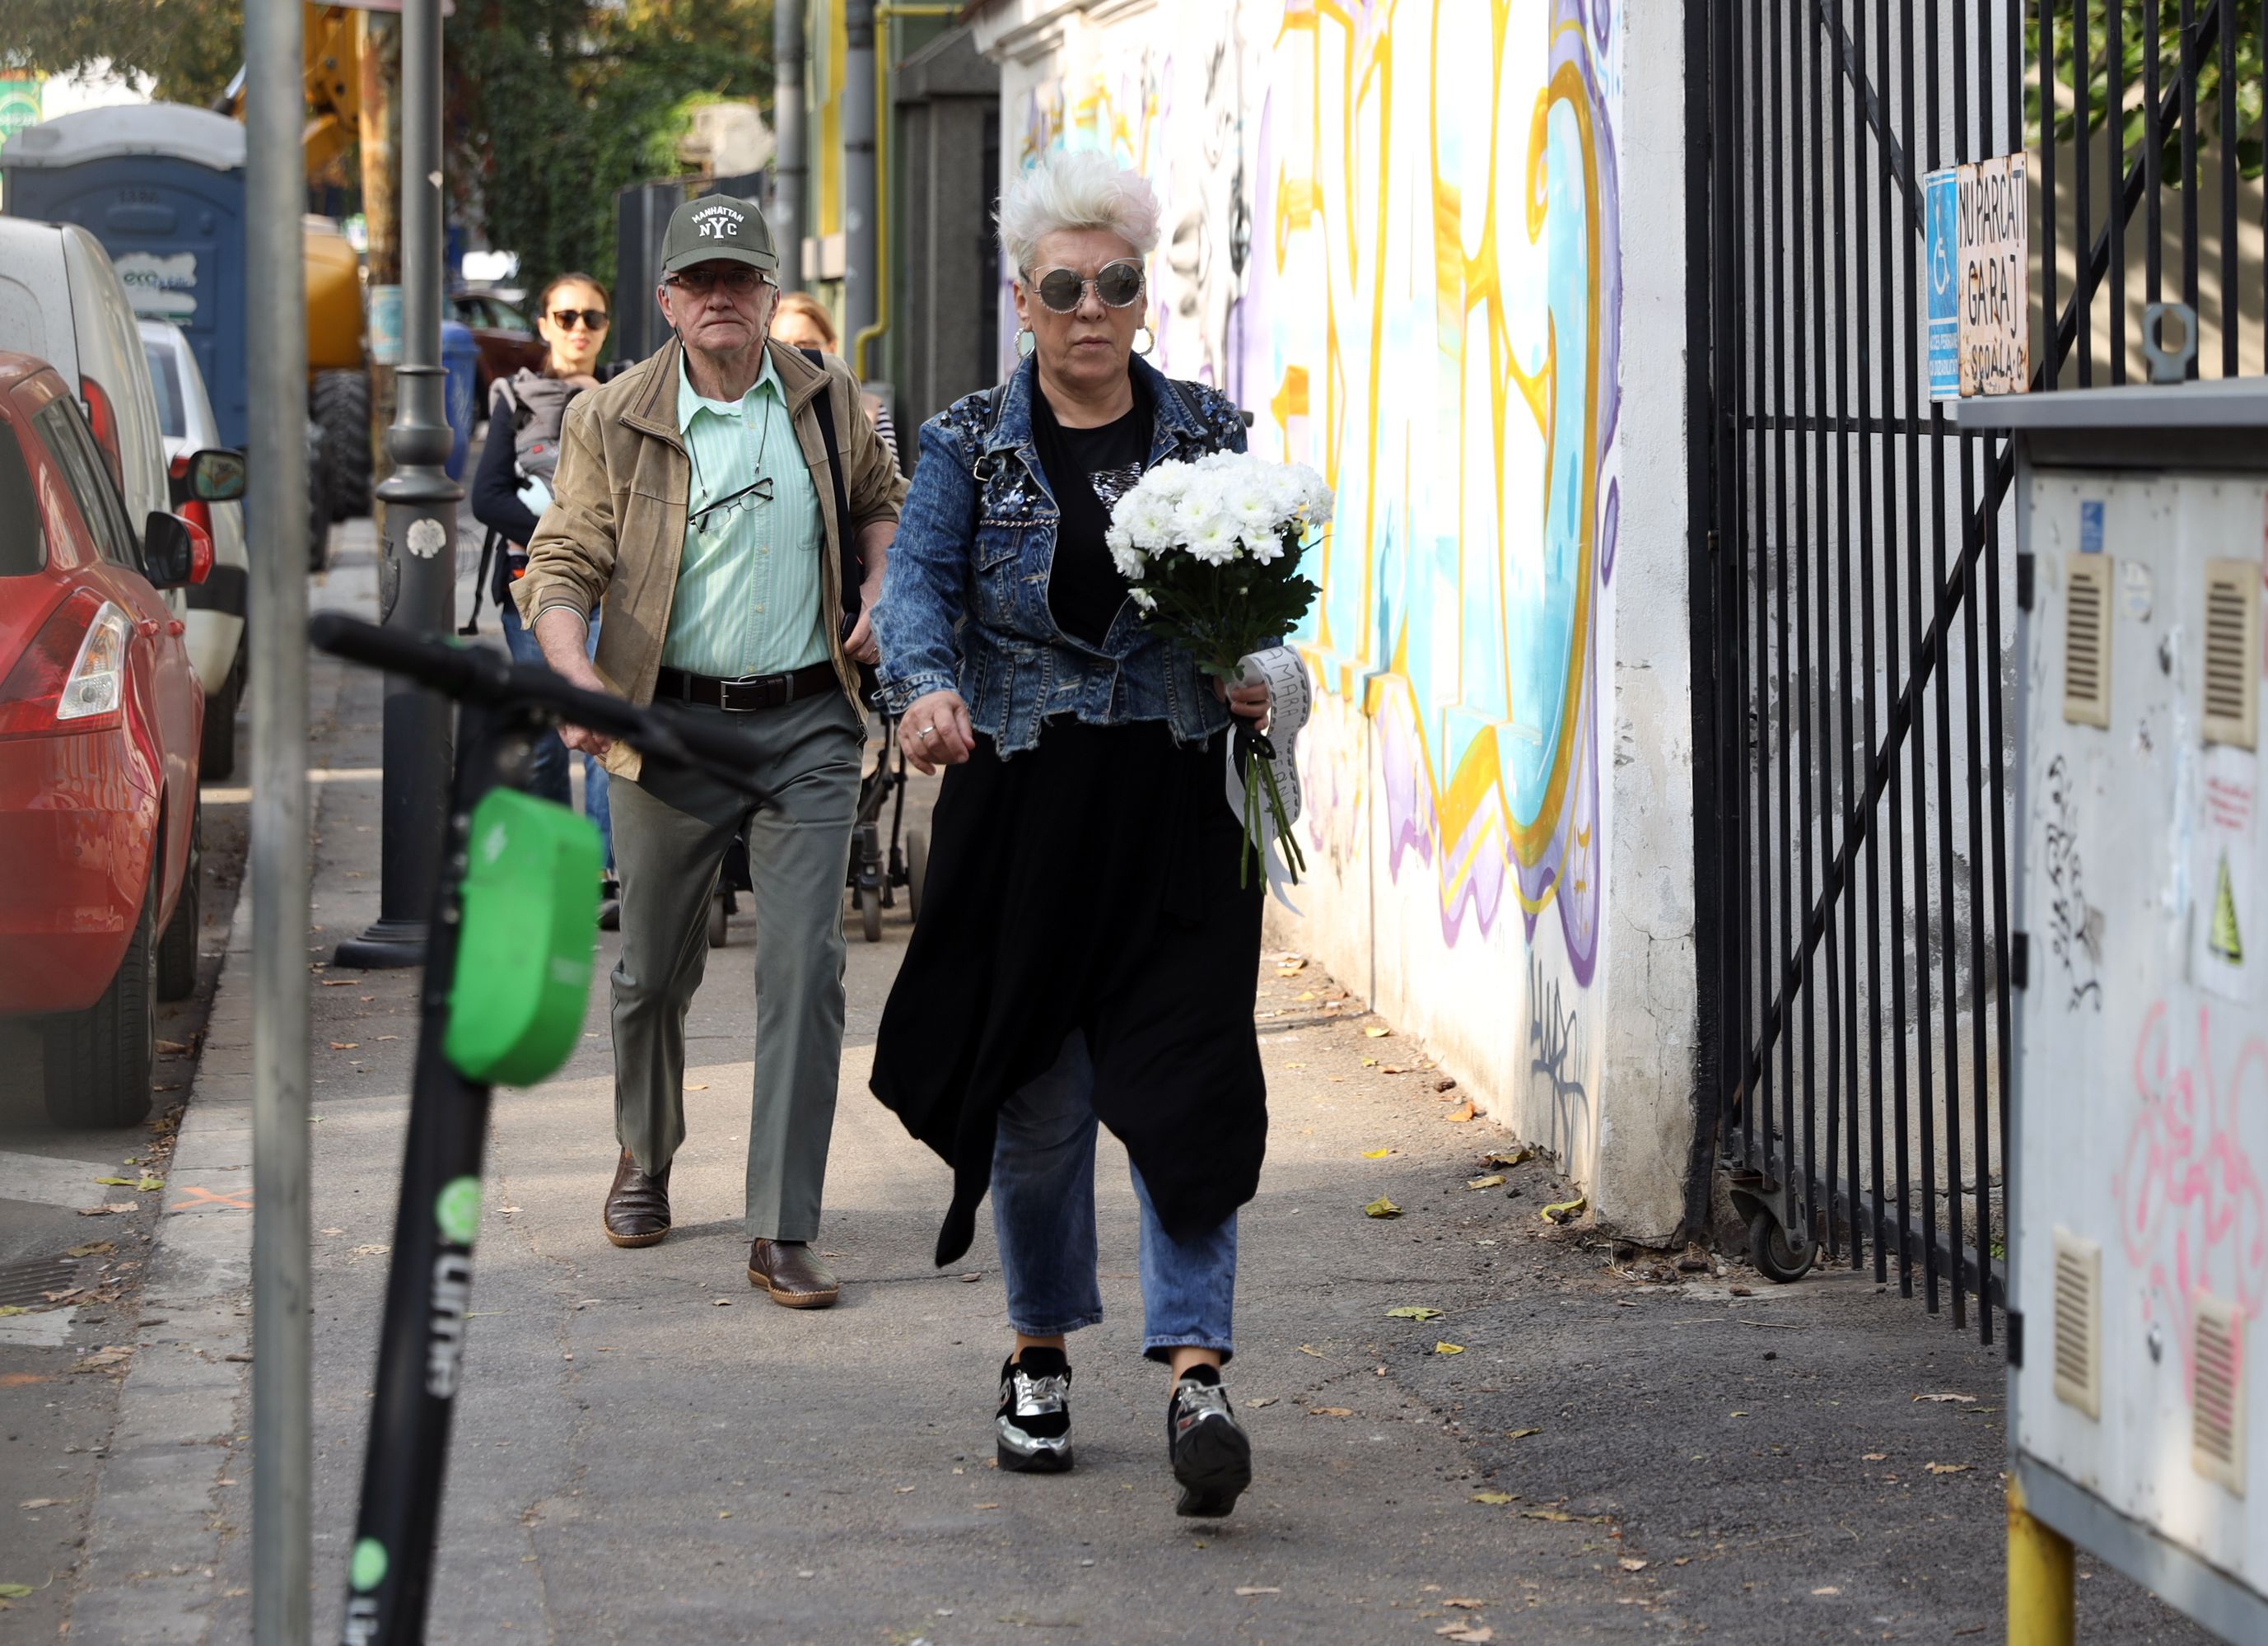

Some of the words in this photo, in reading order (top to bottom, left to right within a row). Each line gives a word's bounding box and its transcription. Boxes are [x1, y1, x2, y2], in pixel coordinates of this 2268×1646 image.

[692, 206, 744, 224] MANHATTAN
[699, 217, 737, 240] NYC
[1958, 180, 1974, 249] NU
[1968, 254, 2017, 339] GARAJ
